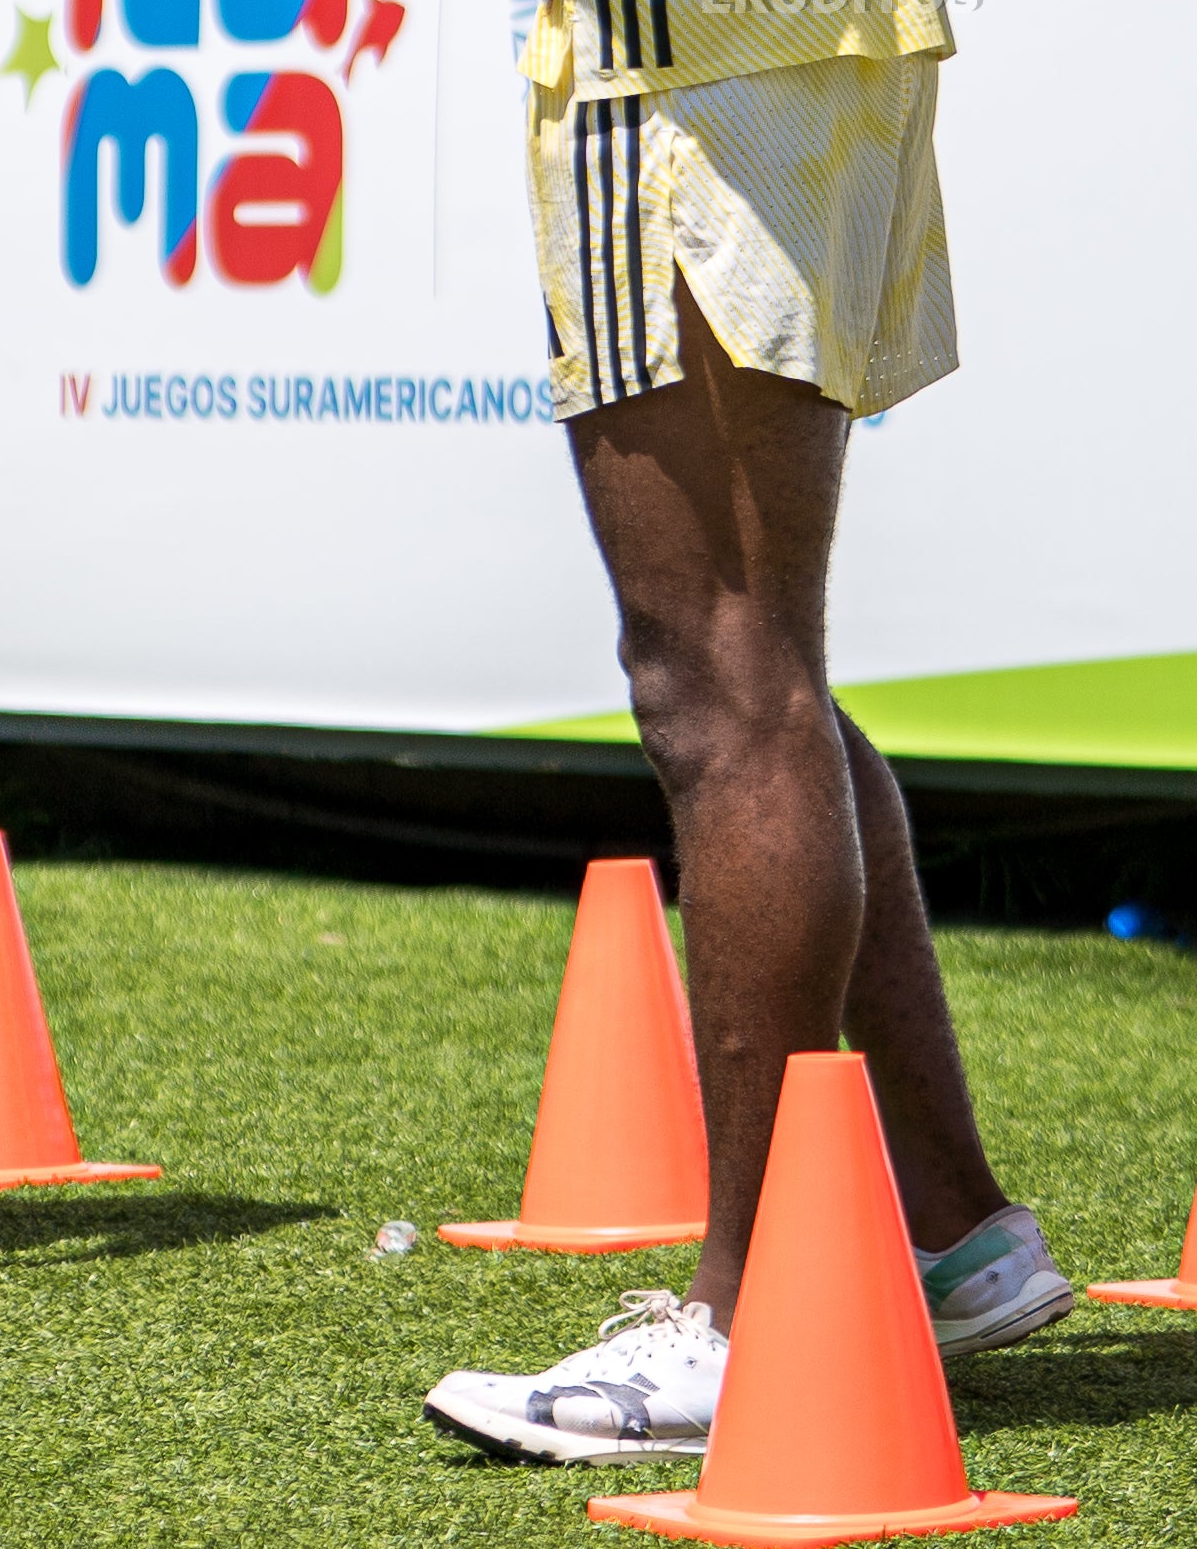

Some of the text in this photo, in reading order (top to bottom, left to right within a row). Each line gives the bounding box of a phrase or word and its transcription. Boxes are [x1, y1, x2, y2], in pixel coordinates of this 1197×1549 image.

[59, 373, 554, 424] IV JUEGOS SURAMERICANOS
